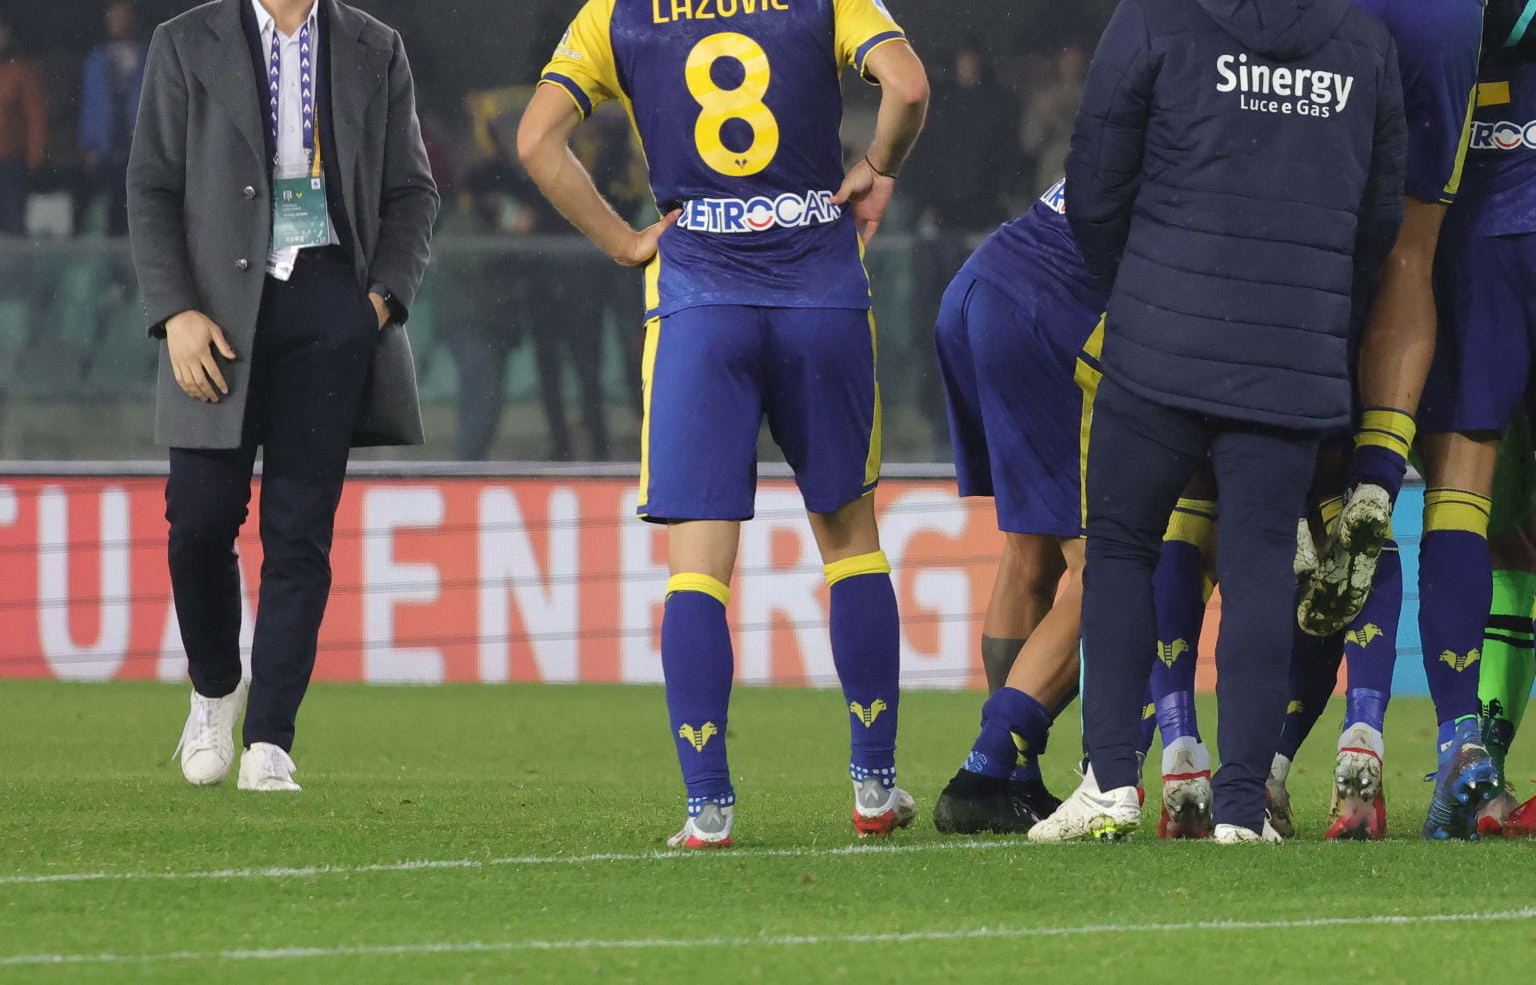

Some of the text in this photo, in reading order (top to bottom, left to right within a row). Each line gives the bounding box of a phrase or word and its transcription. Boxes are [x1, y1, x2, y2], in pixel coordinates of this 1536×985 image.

[685, 32, 779, 176] 8
[1216, 53, 1354, 113] Sinergy
[1240, 94, 1330, 118] Luce e Gas
